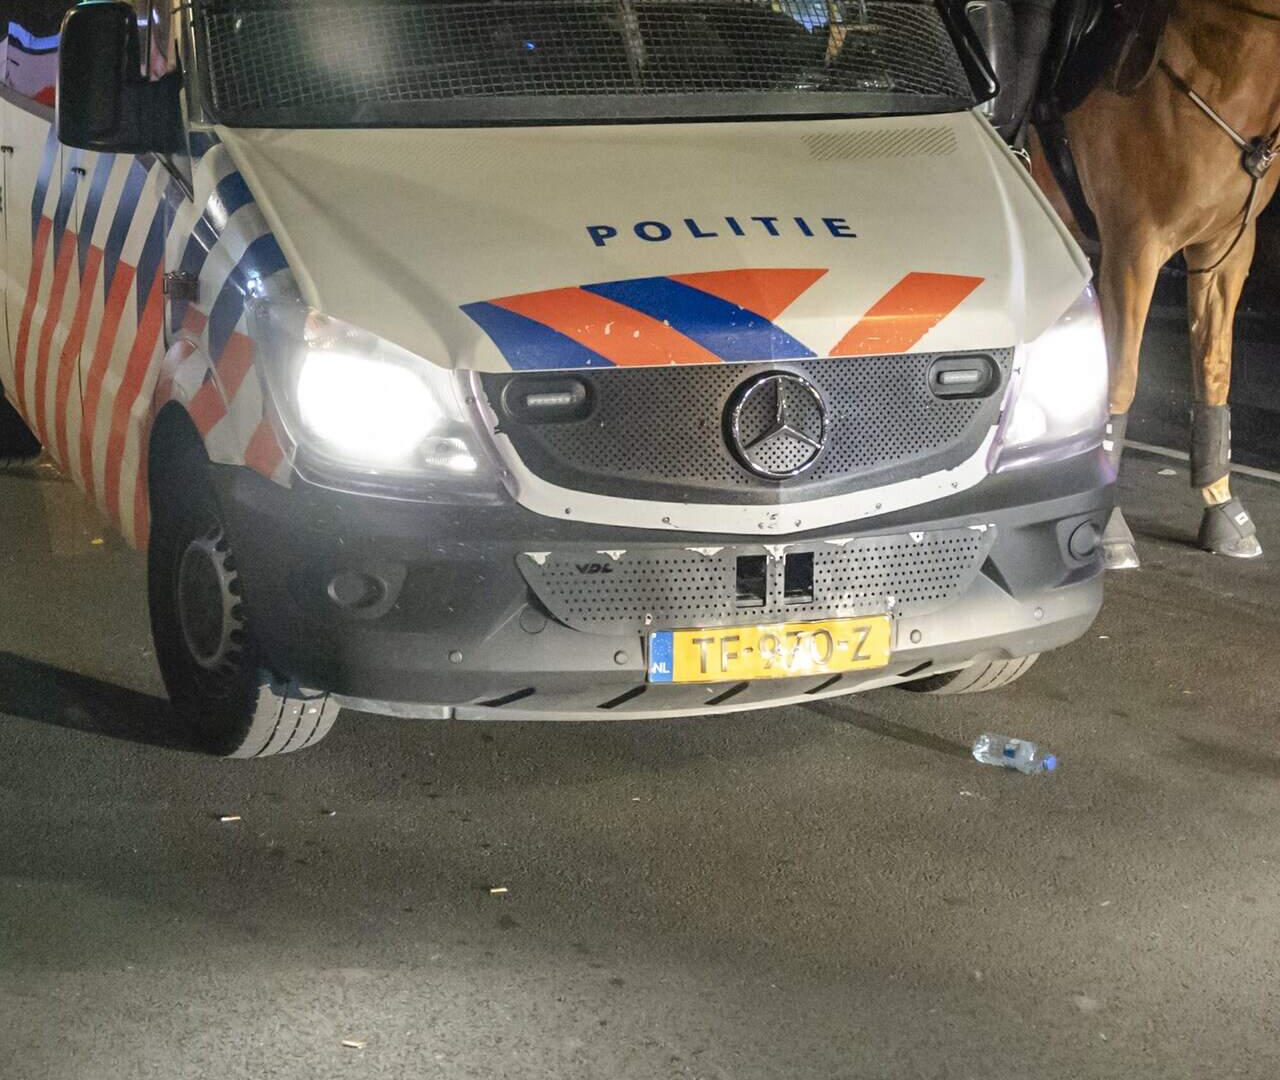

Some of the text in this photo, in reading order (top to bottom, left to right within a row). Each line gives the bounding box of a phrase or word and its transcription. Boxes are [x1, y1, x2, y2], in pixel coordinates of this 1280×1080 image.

[585, 216, 858, 248] POLITIE
[575, 562, 612, 575] VDL
[691, 625, 873, 675] TF-970-Z
[652, 662, 671, 675] NL
